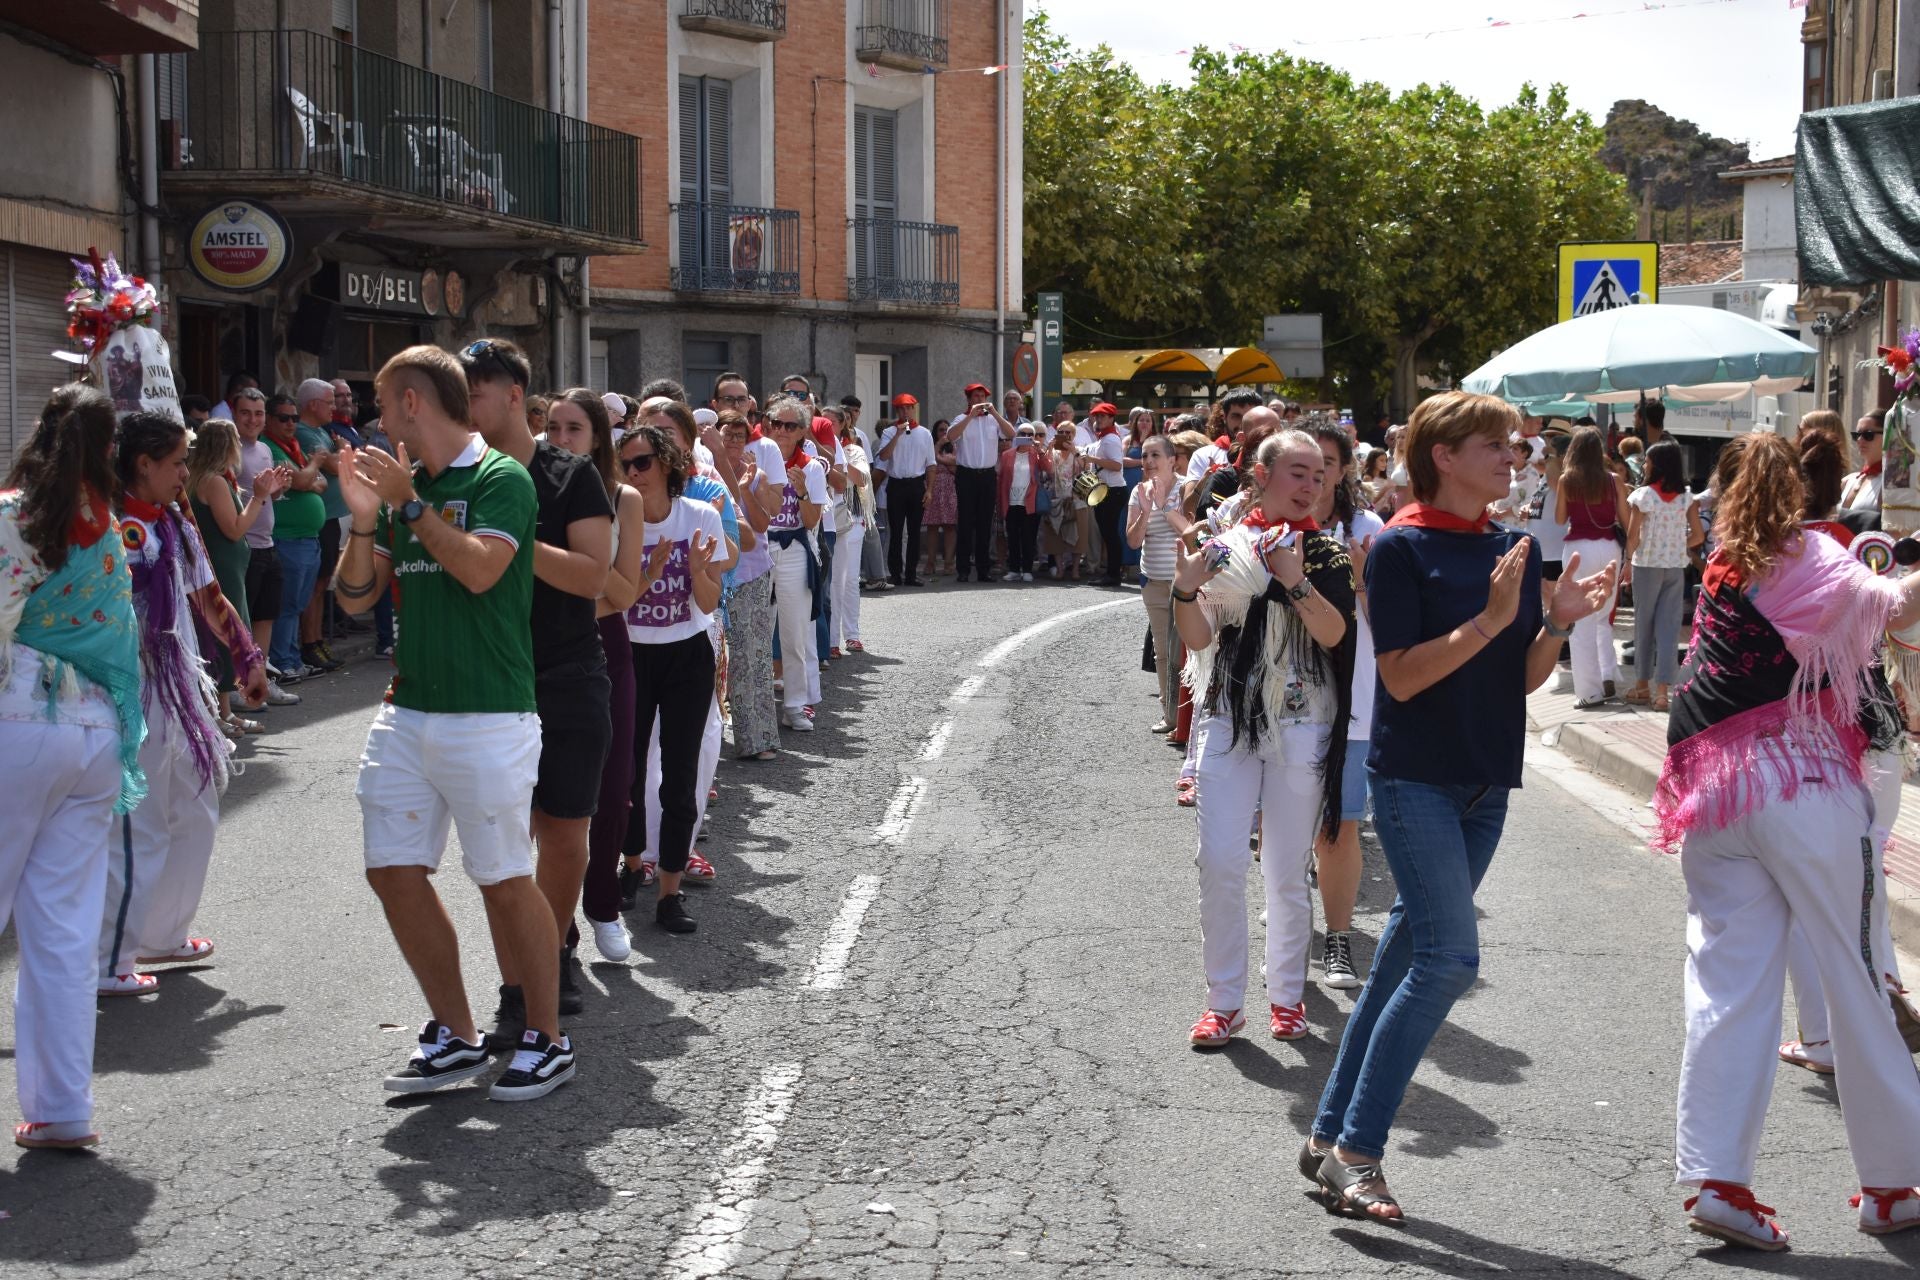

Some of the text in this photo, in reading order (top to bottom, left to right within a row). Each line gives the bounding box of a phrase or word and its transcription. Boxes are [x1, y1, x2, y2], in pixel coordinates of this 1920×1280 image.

[205, 231, 264, 246] AMSTEL
[231, 251, 256, 259] MALTA
[144, 385, 175, 400] SANTA
[650, 575, 685, 594] OM
[636, 602, 683, 621] POM
